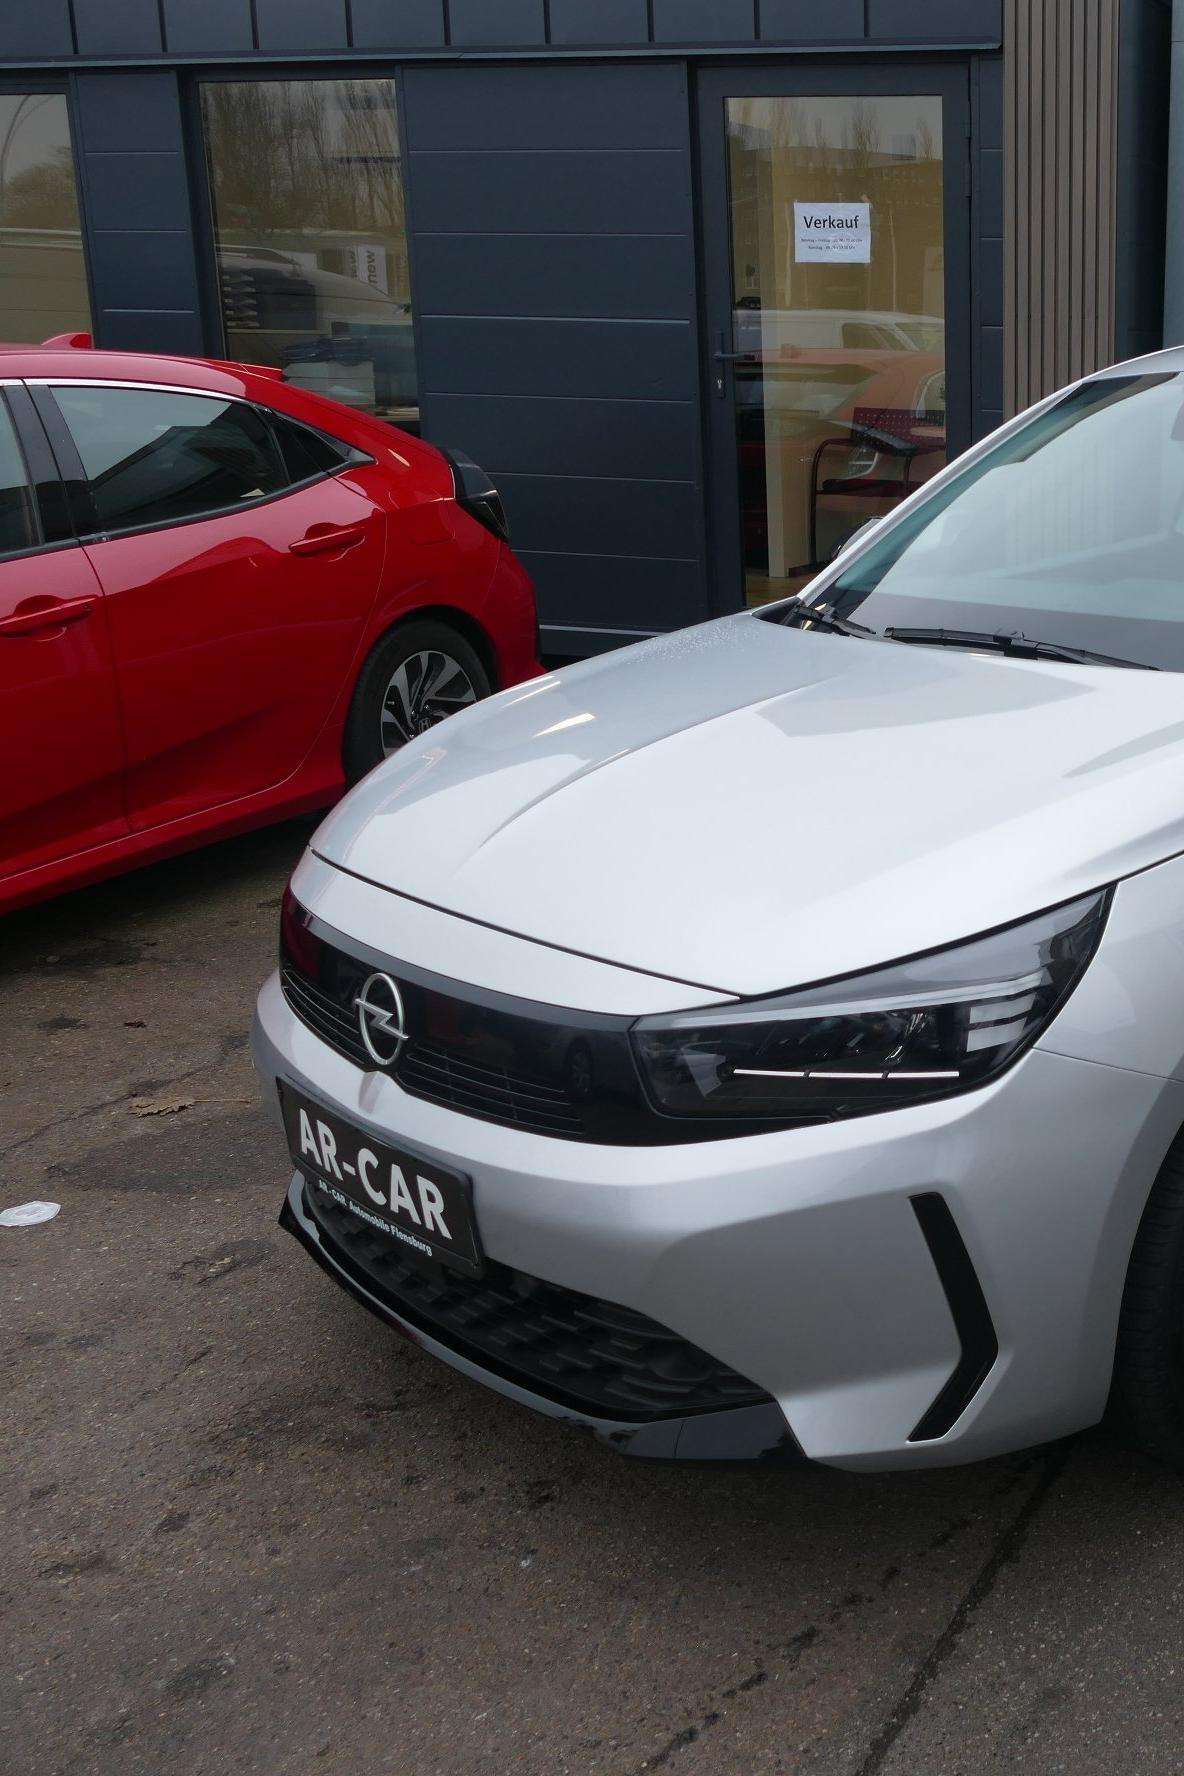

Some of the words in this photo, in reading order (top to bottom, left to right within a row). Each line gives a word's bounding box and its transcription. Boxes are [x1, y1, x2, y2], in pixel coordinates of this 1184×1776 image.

[803, 215, 860, 229] Verkauf
[299, 1108, 453, 1240] AR-CAR
[390, 1224, 433, 1257] Flensburg
